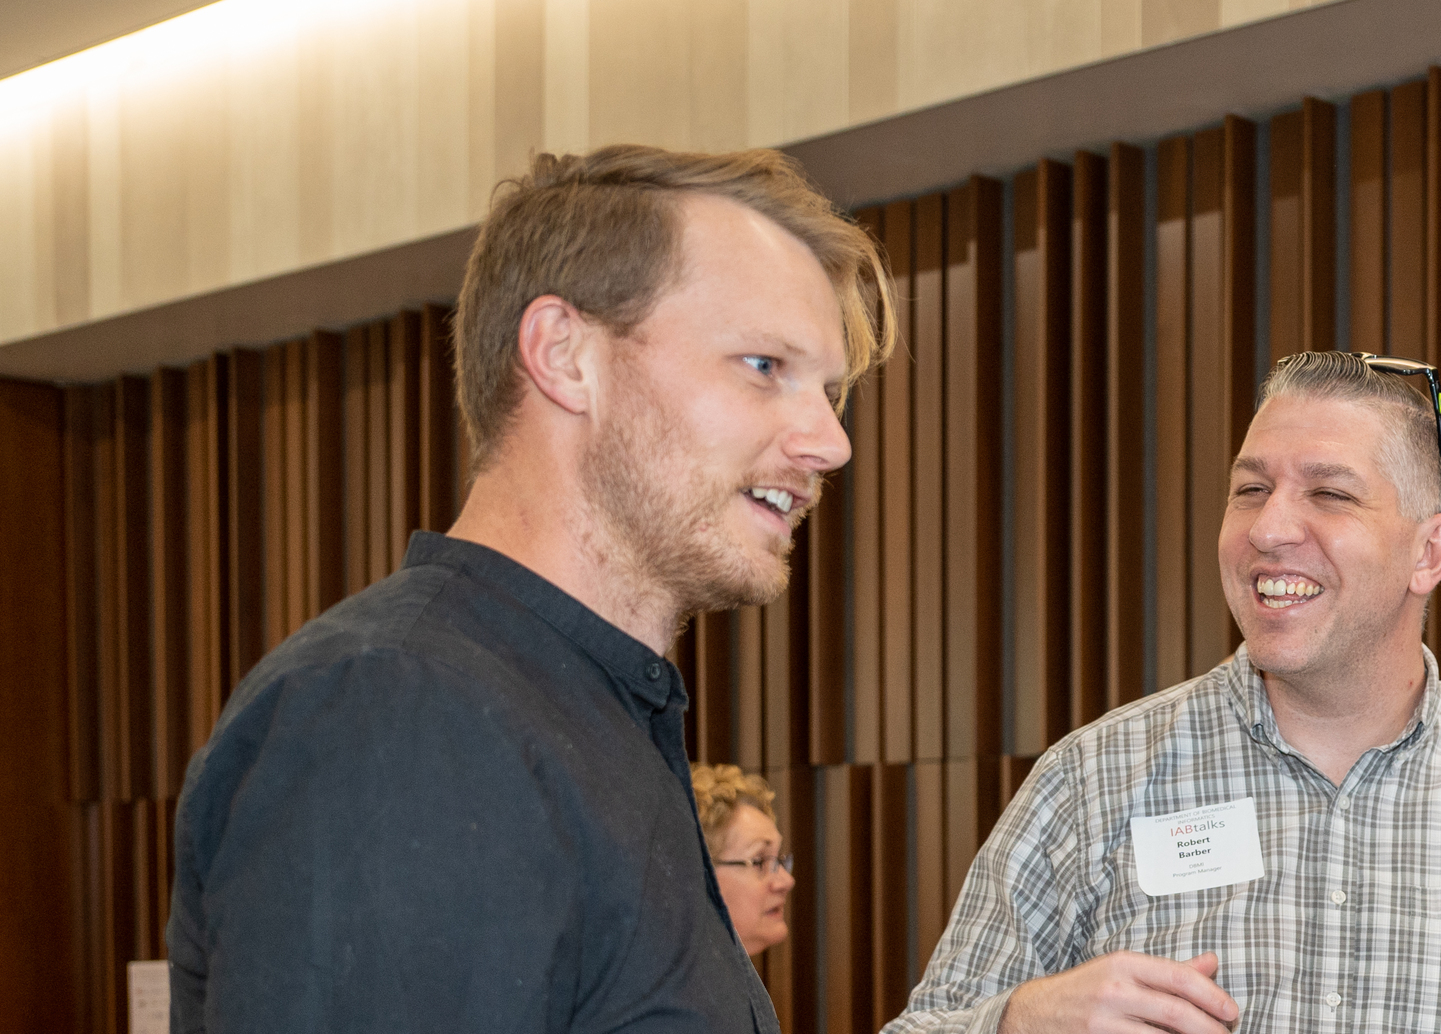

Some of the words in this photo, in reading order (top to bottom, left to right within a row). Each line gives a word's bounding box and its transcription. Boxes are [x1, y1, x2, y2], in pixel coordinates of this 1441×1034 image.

[1155, 812, 1192, 823] DEPARTMENT
[1202, 805, 1236, 814] BIOMEDICAL
[1177, 814, 1216, 824] INFORMATICS
[1170, 820, 1226, 837] IABtalks
[1177, 837, 1211, 848] Robert
[1179, 848, 1212, 858] Barber
[1172, 870, 1197, 878] Program
[1197, 866, 1222, 874] Manager
